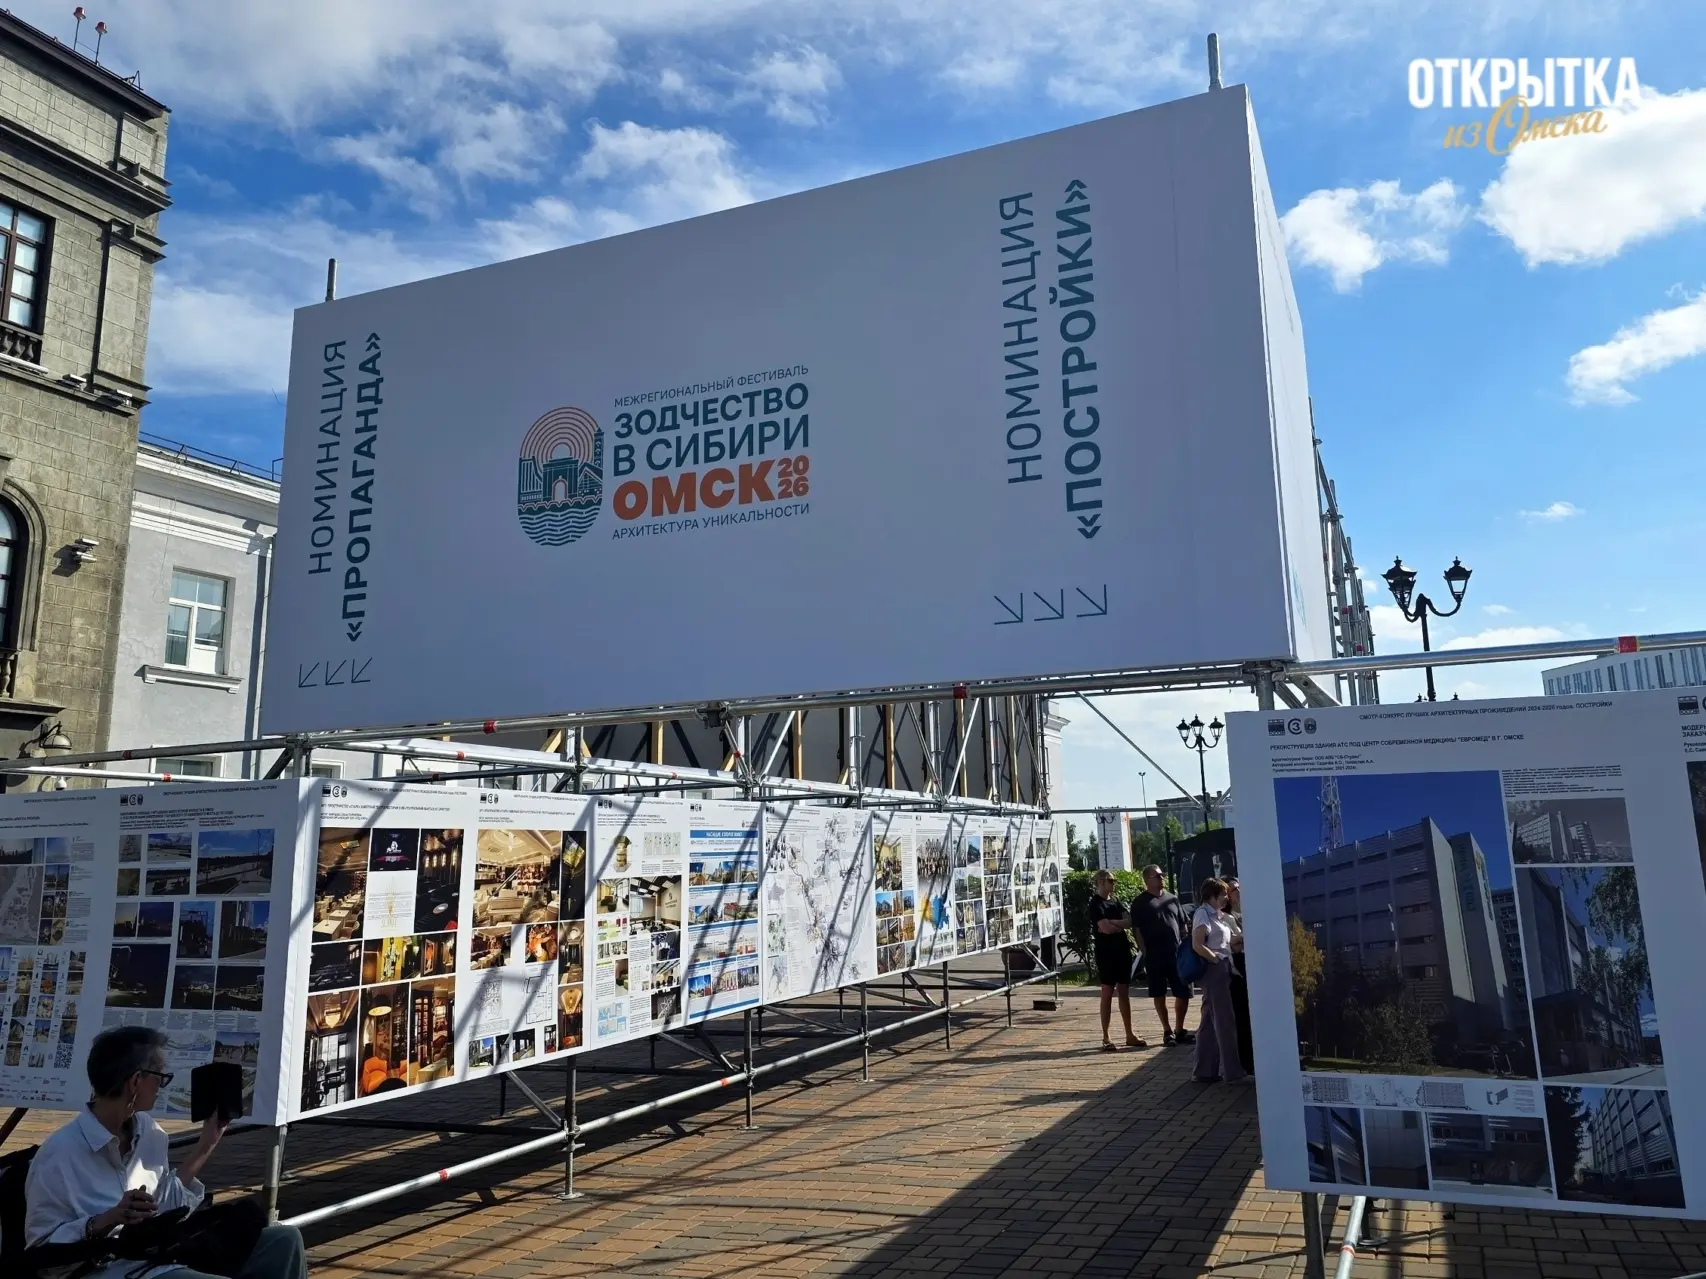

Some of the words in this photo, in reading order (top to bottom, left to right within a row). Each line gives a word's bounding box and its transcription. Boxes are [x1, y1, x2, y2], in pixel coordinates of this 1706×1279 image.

[999, 192, 1042, 484] НОМИНАЦИЯ
[1048, 178, 1103, 539] «ПОСТРОЙКИ»
[614, 376, 734, 407] МЕЖРЕГИОНАЛЬНЫЙ
[737, 364, 809, 386] ФЕСТИВАЛЬ
[614, 382, 809, 439] ЗОДЧЕСТВО
[308, 340, 347, 575] НОМИНАЦИЯ
[613, 443, 636, 477] В
[646, 415, 809, 471] СИБИРИ
[342, 332, 384, 642] «ПРОПАГАНДА»
[613, 460, 776, 521] ОМСК
[612, 519, 699, 540] АРХИТЕКТУРА
[703, 503, 809, 529] УНИКАЛЬНОСТИ
[1575, 701, 1613, 709] ПОСТРОЙКИ
